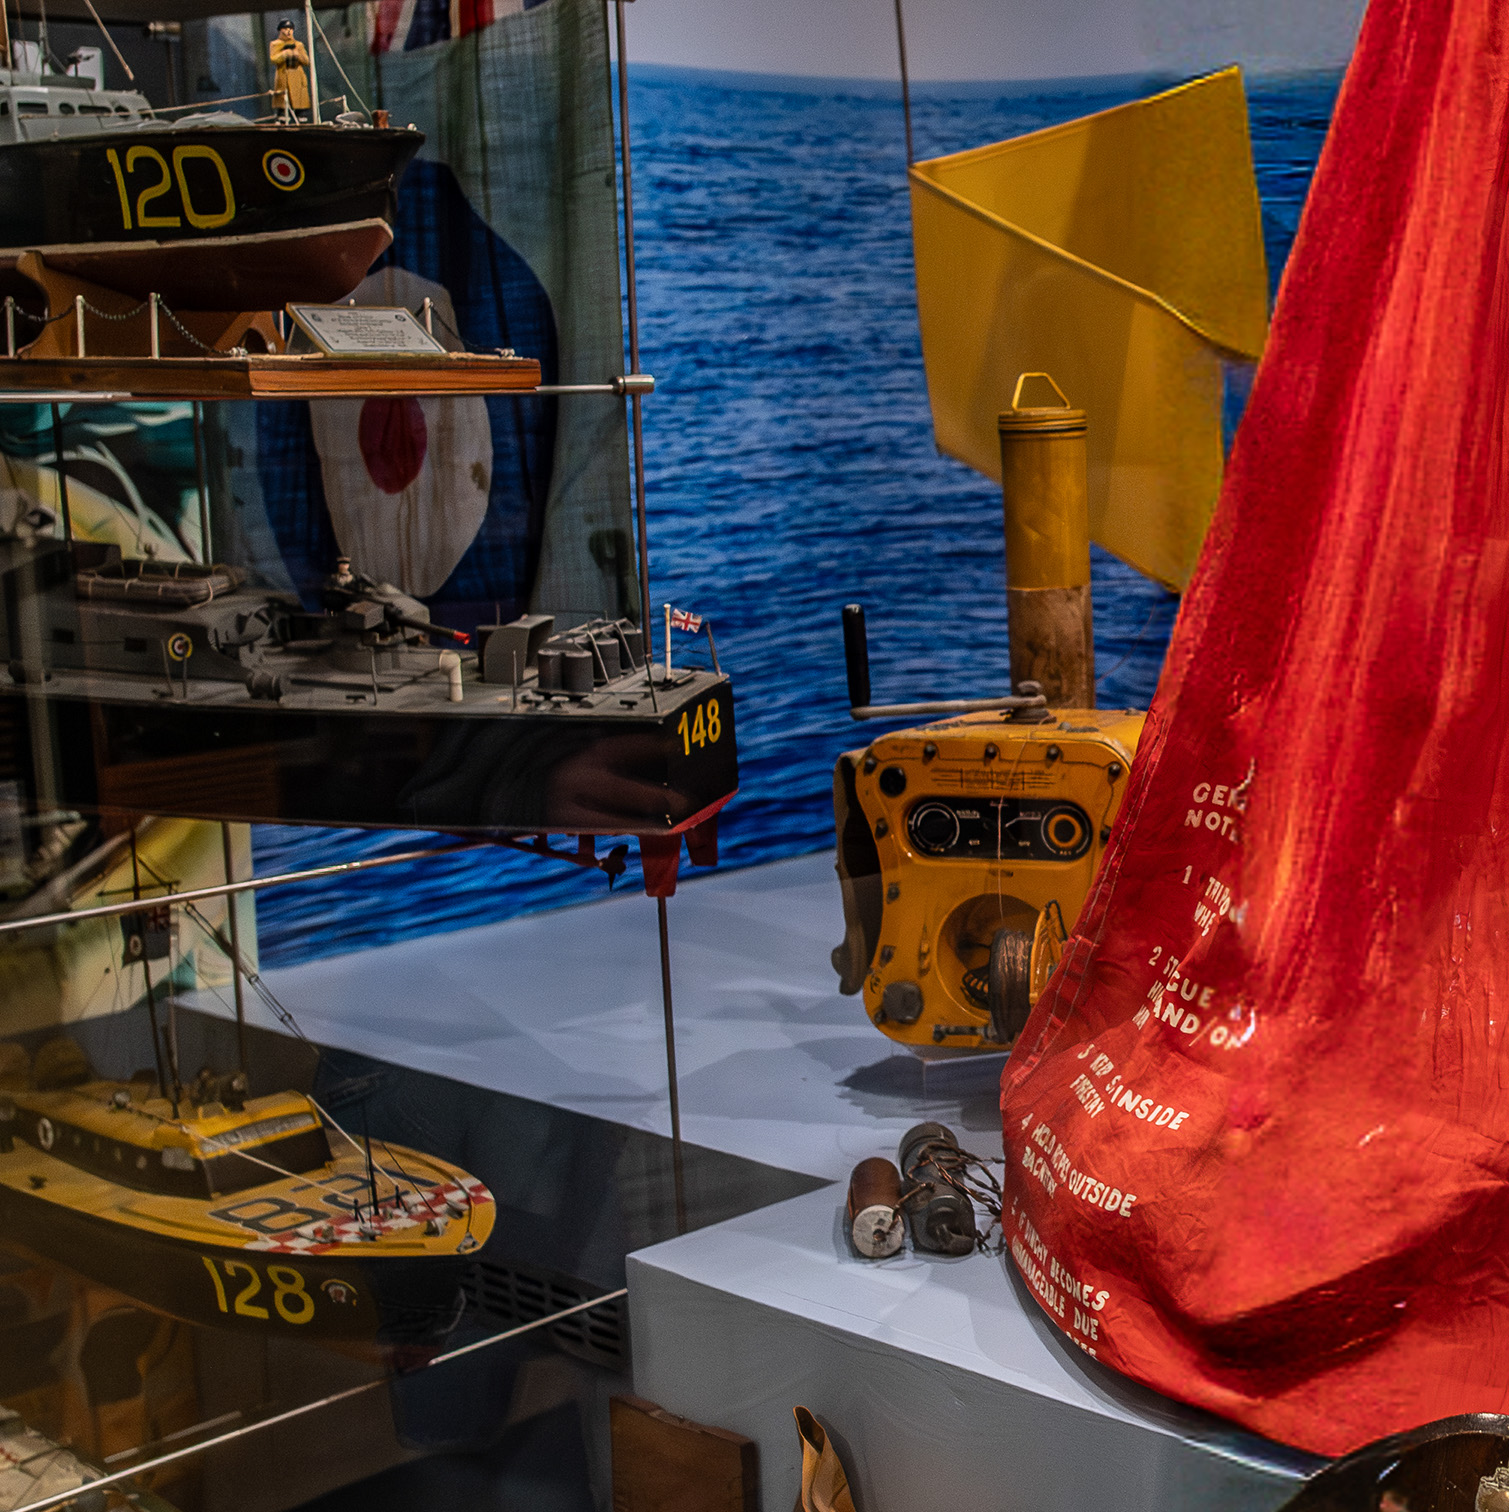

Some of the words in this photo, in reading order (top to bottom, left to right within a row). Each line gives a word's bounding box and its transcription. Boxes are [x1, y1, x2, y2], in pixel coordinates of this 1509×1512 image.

[106, 145, 236, 230] 120
[677, 697, 723, 756] 148
[1182, 864, 1193, 885] 1
[1148, 946, 1162, 966] 2
[1068, 1168, 1137, 1218] OUTSIDE
[202, 1256, 316, 1325] 128
[1073, 1306, 1100, 1342] DUE
